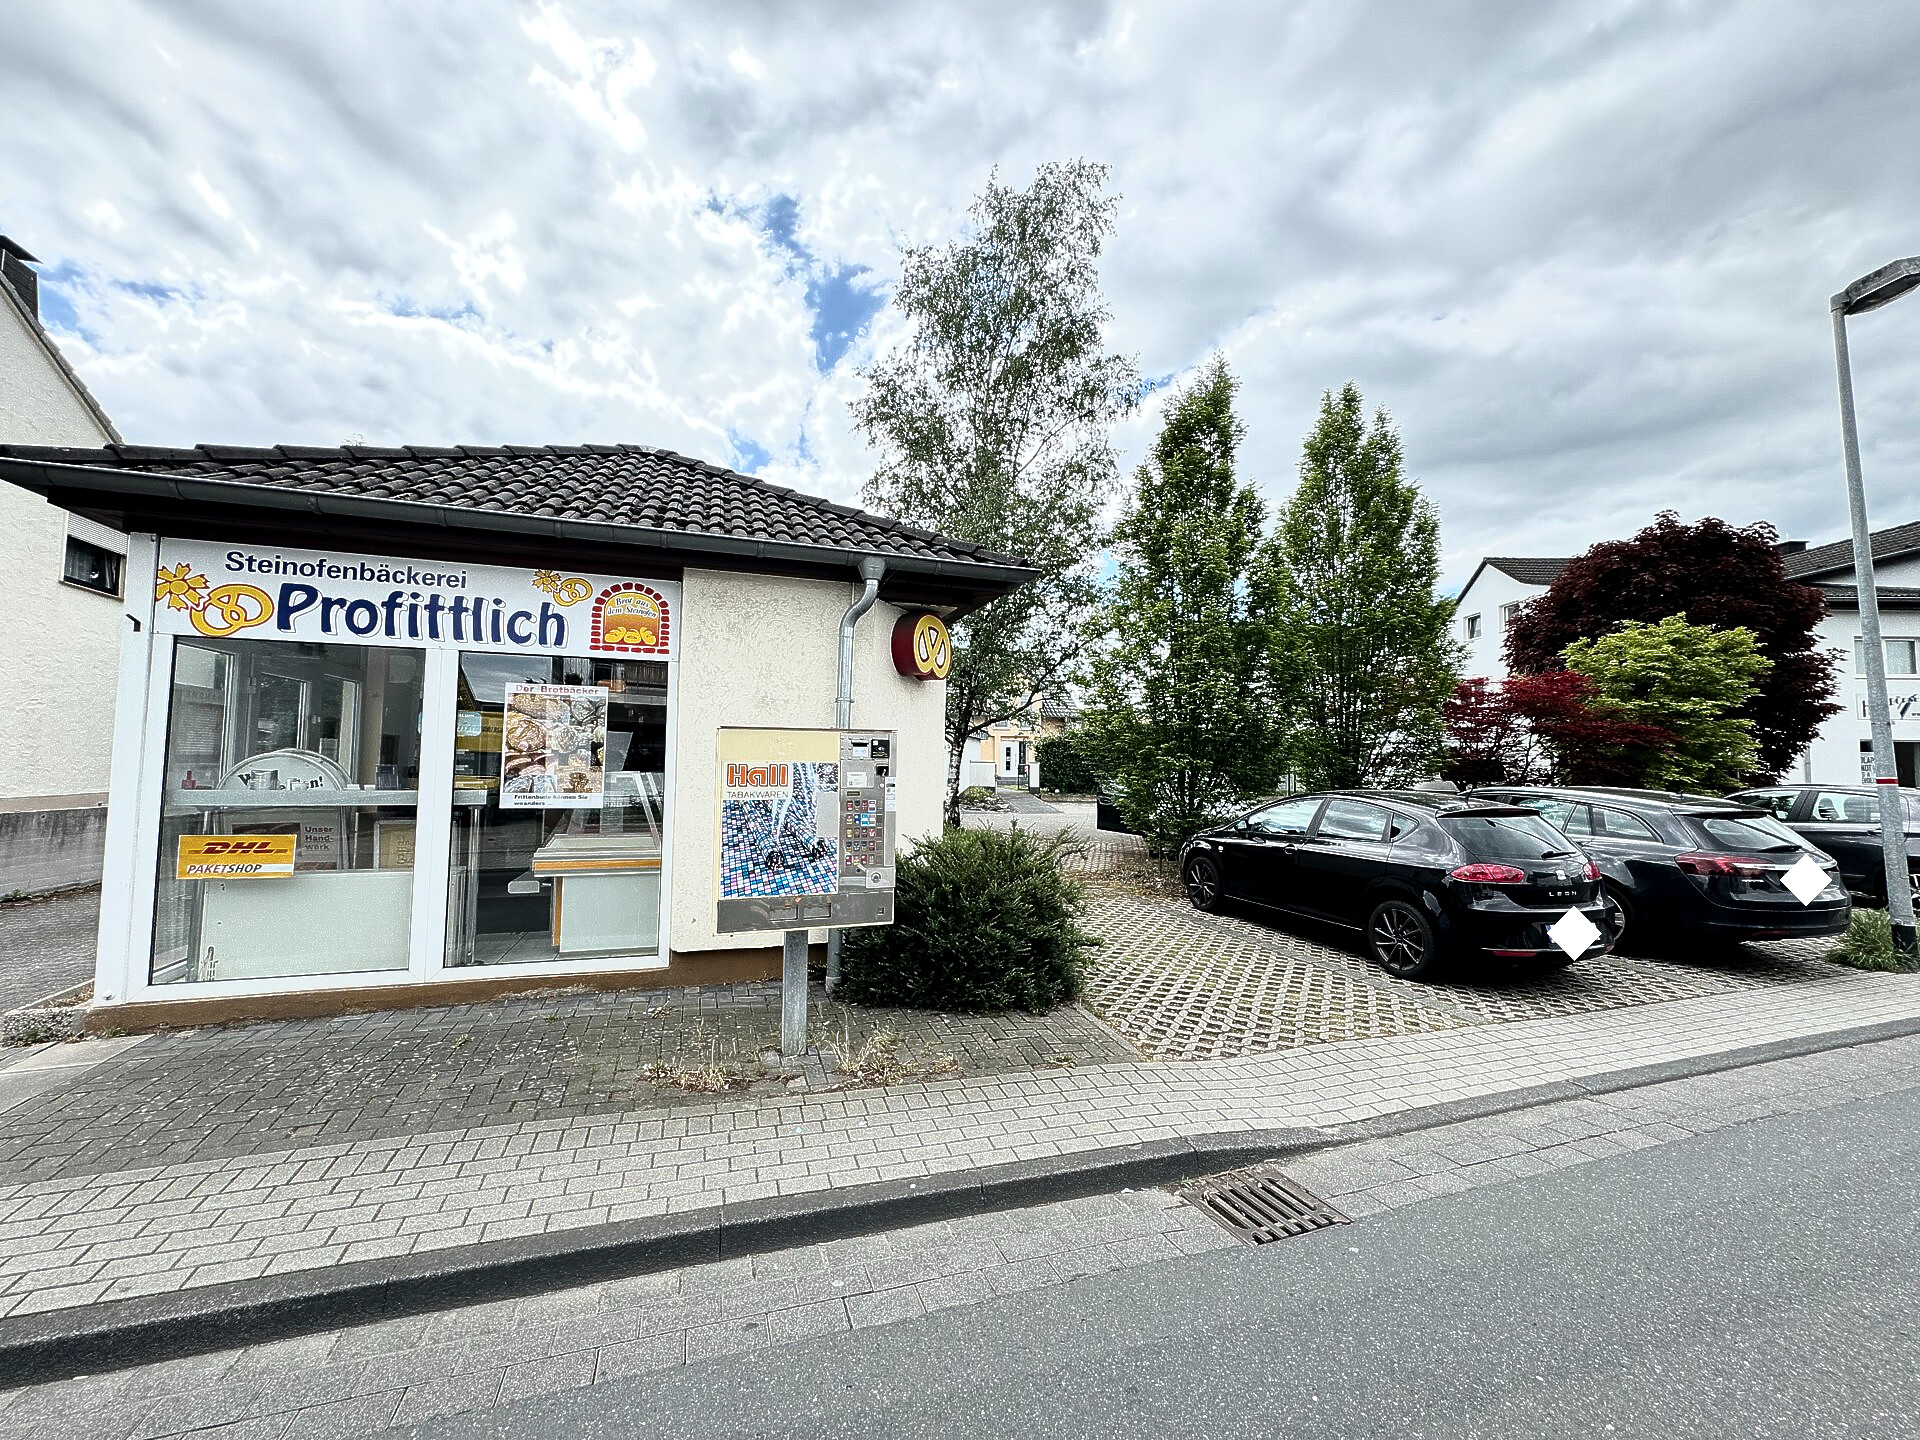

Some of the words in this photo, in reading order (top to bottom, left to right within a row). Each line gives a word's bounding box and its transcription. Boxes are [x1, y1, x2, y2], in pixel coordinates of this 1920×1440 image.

[225, 551, 467, 589] Steinofenbäckerei
[616, 597, 633, 606] Brot
[635, 599, 650, 608] aus
[276, 583, 570, 650] Profittlich
[626, 605, 657, 618] Steinofen
[727, 763, 789, 788] Hall
[726, 791, 789, 799] TABAKWAREN
[304, 825, 334, 833] Unser
[201, 841, 276, 855] DHL
[187, 864, 262, 874] PAKETSHOP
